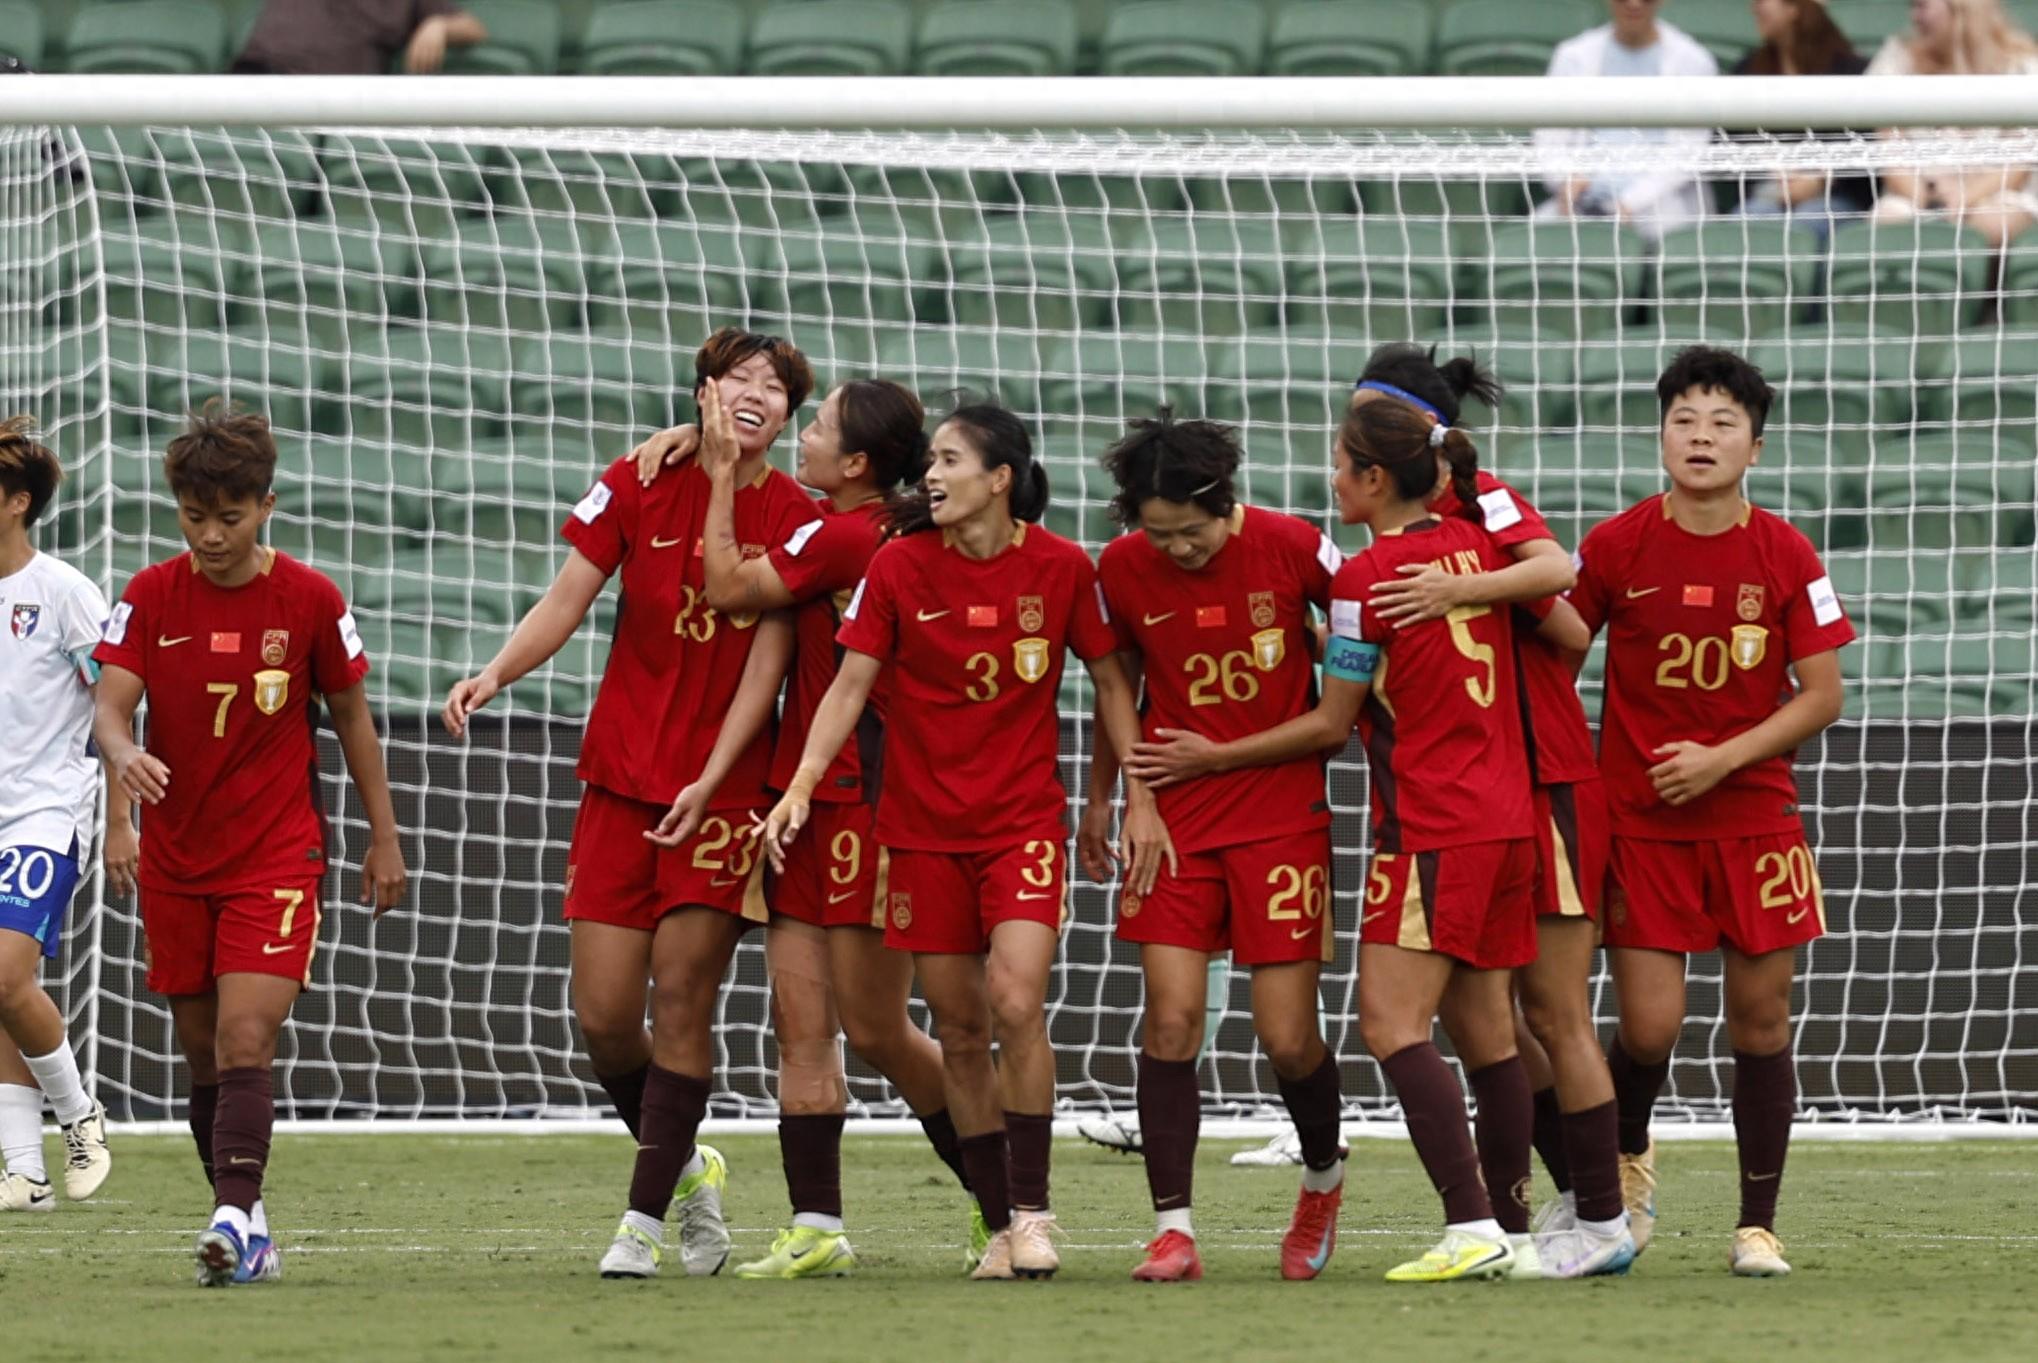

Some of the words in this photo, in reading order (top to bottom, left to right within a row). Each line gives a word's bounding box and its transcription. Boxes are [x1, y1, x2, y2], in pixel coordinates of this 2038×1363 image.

[674, 585, 717, 643] 23
[965, 652, 999, 701] 3
[1184, 650, 1259, 706] 26
[1446, 606, 1495, 708] 5
[1656, 633, 1729, 690] 20
[207, 683, 238, 737] 7
[692, 816, 757, 876] 23
[830, 830, 861, 884] 9
[1021, 840, 1056, 887] 3
[0, 847, 54, 900] 20
[1266, 865, 1325, 920] 26
[1367, 854, 1396, 904] 5
[1755, 846, 1809, 909] 20
[274, 890, 304, 938] 7
